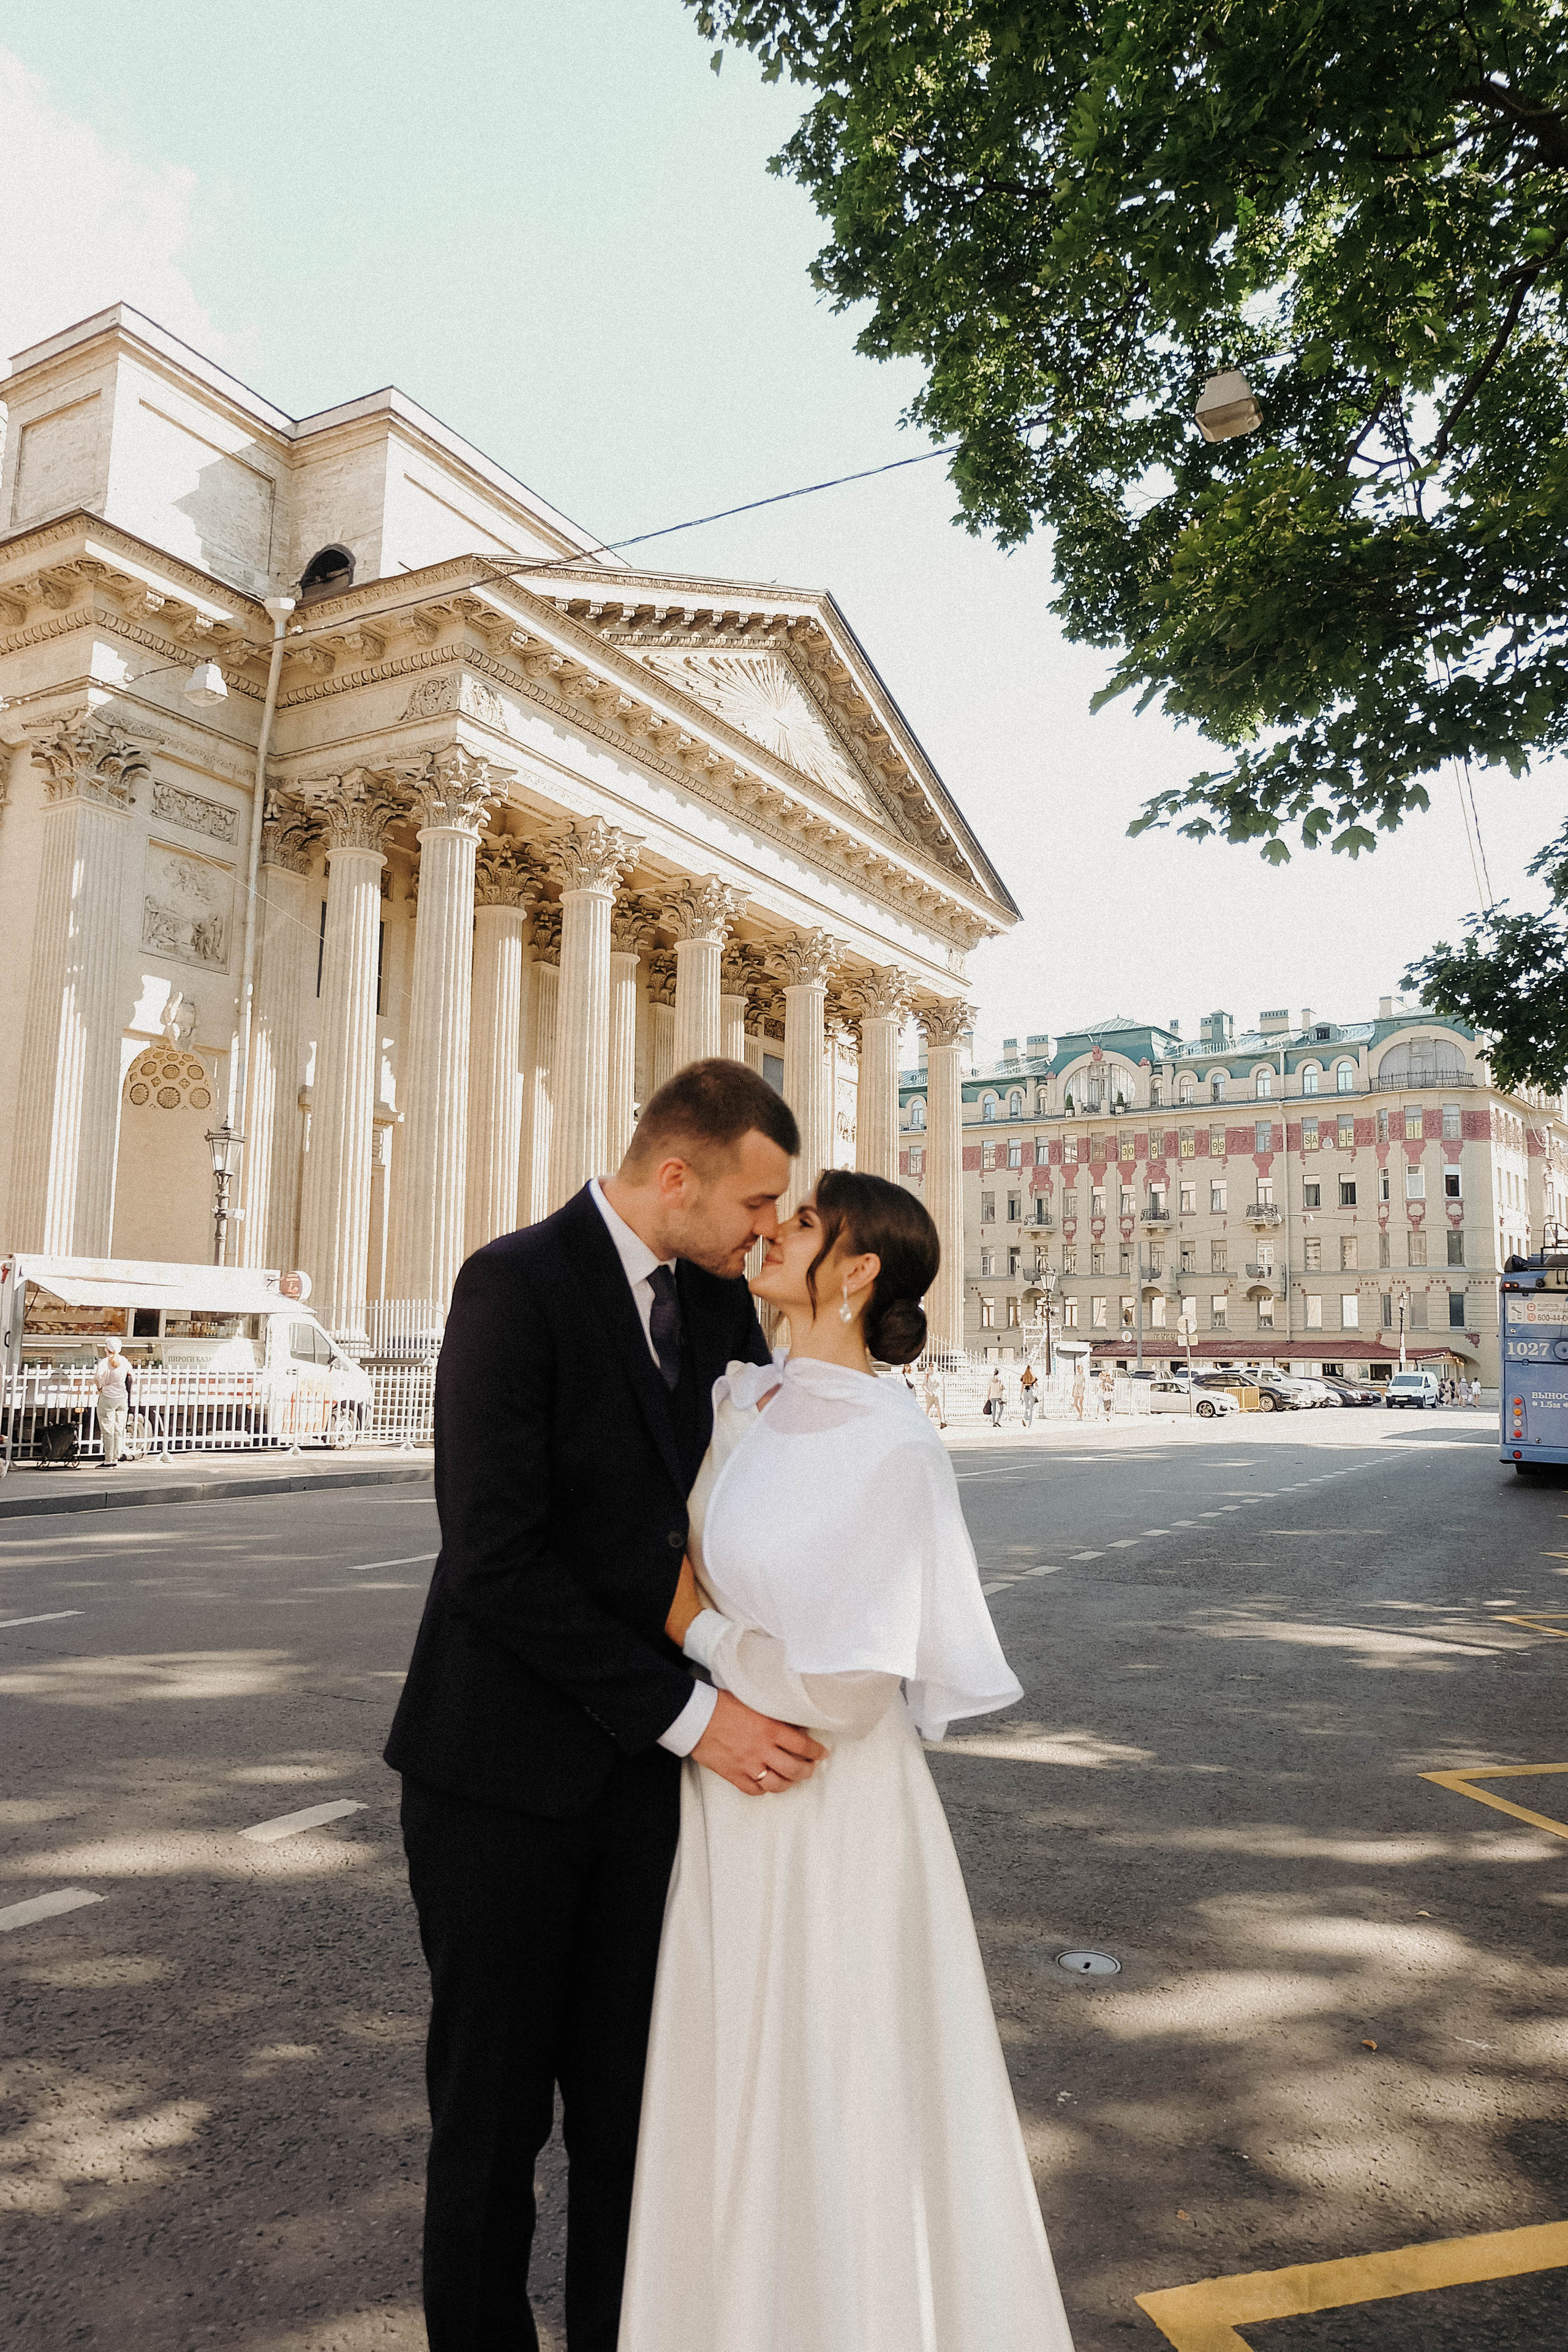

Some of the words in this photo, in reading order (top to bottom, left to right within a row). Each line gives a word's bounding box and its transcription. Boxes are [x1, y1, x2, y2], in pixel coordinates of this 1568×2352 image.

[1122, 1147, 1134, 1156] 30
[1182, 1144, 1194, 1152] 18
[1212, 1142, 1224, 1150] 99
[1507, 1341, 1550, 1356] 1027
